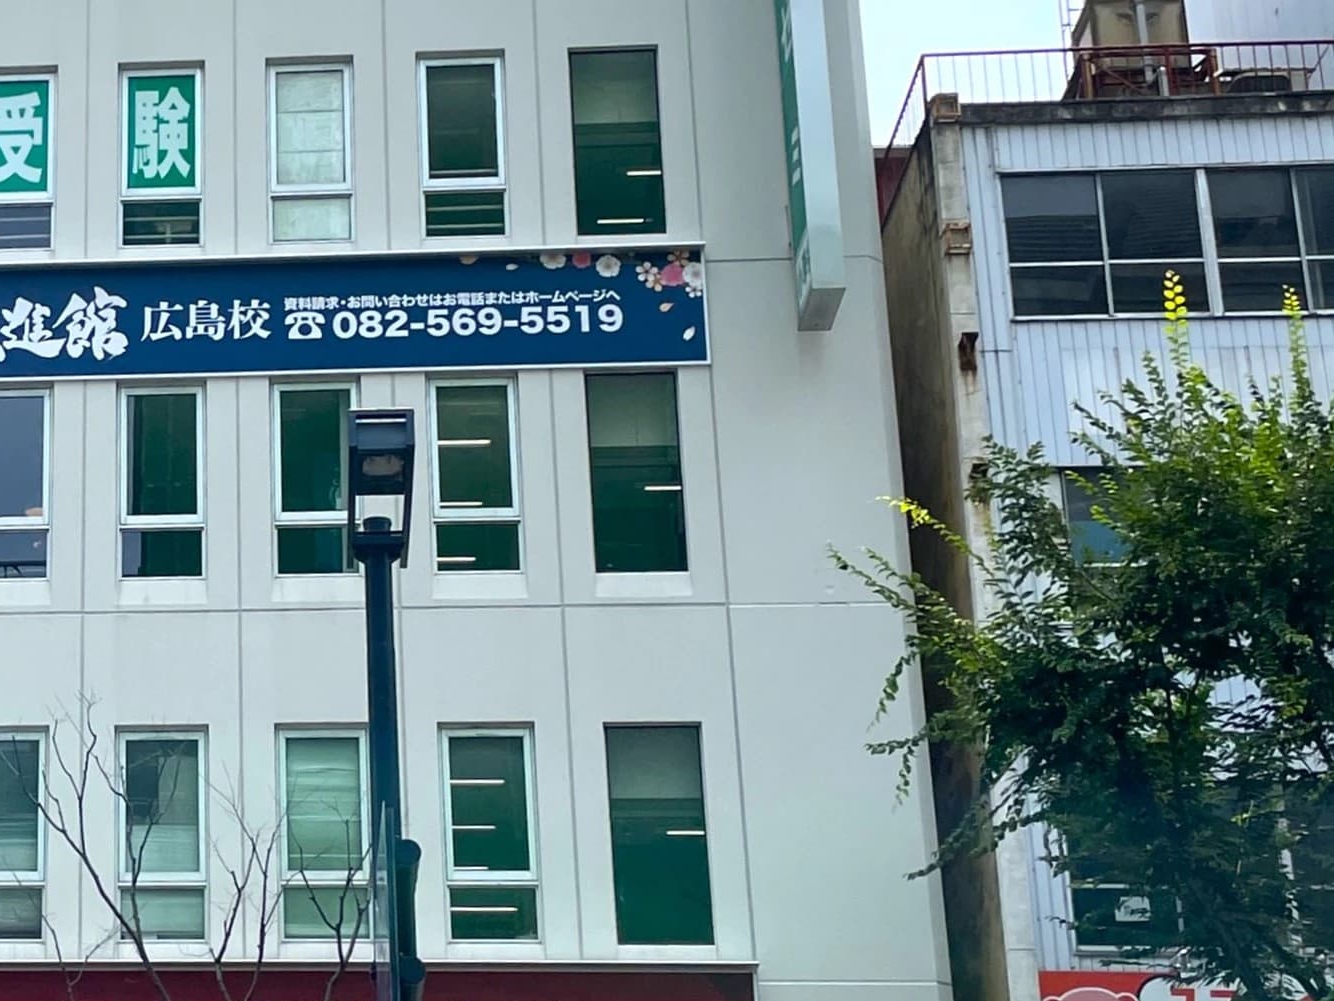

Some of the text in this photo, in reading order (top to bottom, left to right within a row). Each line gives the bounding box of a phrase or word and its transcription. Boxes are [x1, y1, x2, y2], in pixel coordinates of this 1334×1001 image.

[140, 299, 271, 341] 広島校
[332, 304, 625, 339] 082-569-5519
